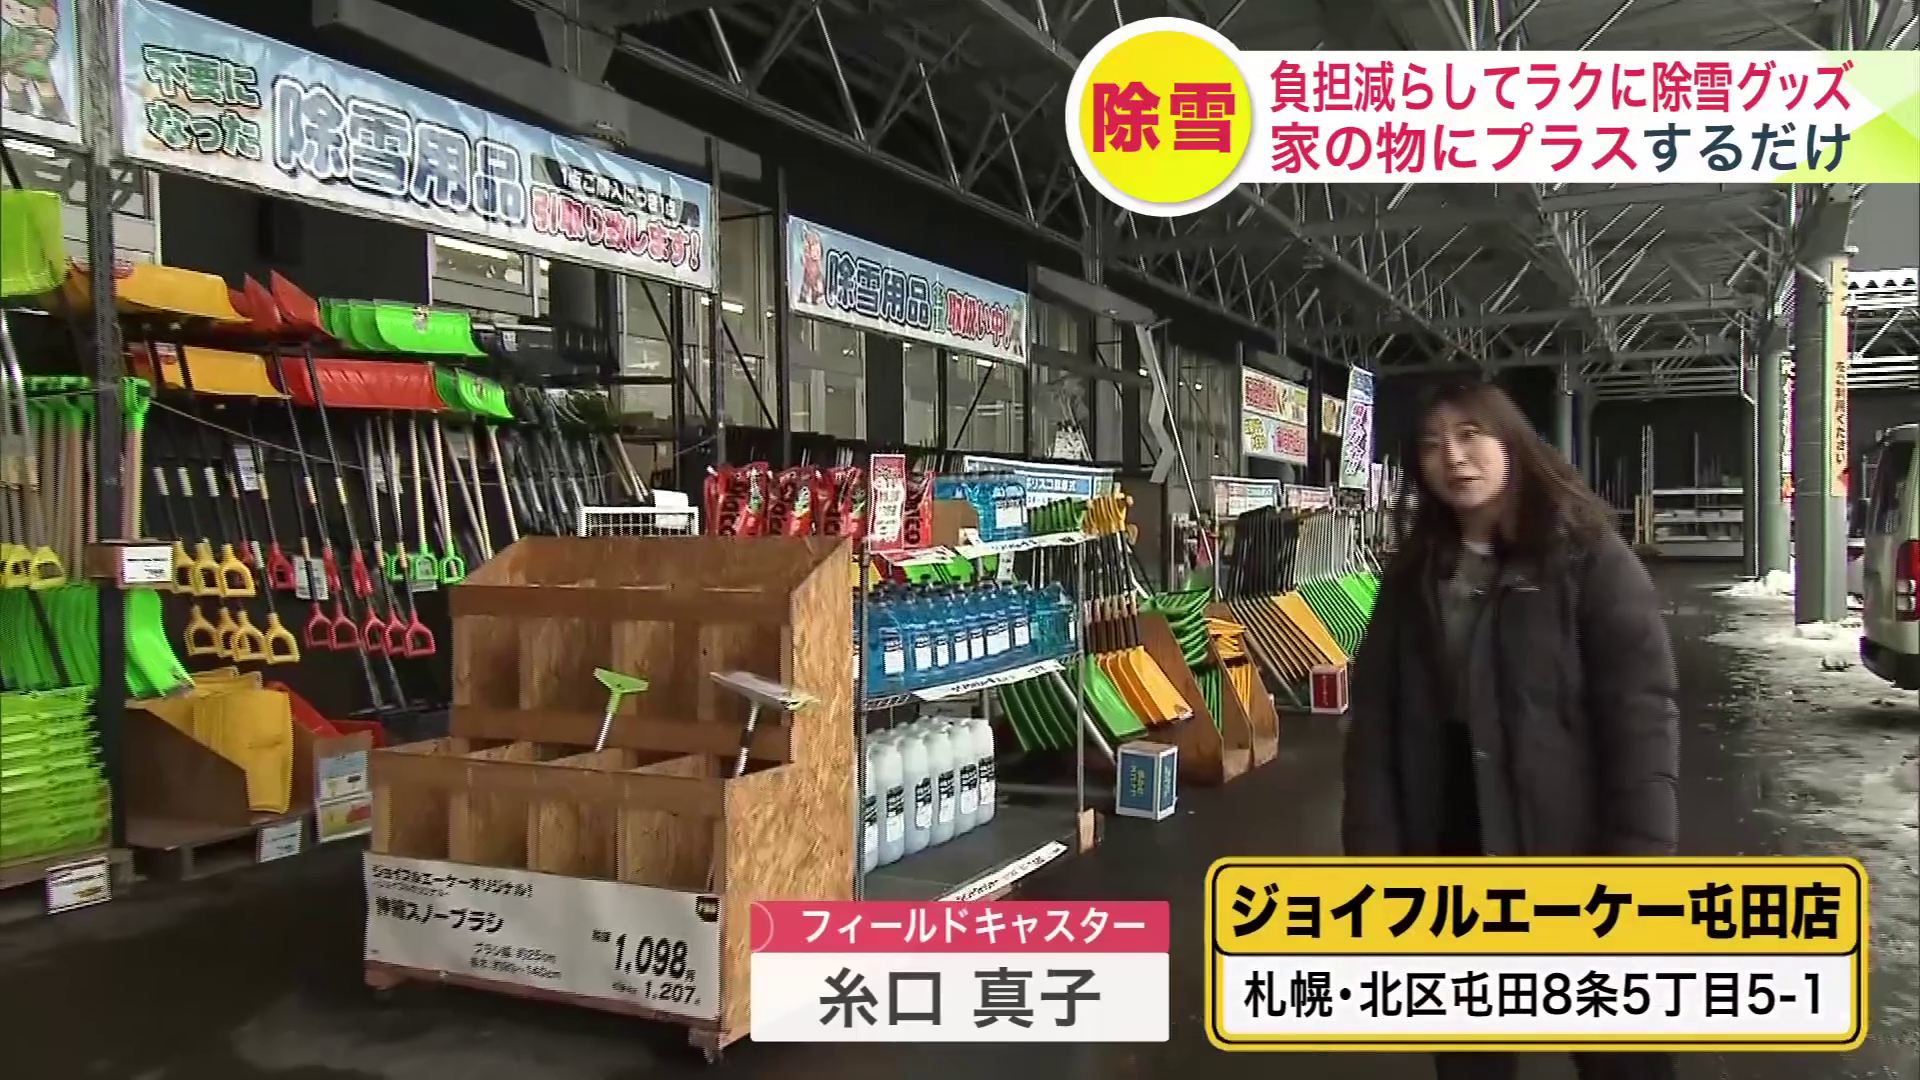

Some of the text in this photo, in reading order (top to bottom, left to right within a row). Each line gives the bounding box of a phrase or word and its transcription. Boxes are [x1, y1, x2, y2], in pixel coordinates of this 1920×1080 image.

[142, 45, 261, 108] 不要に
[146, 100, 262, 160] なった
[272, 75, 527, 226] 除雪用品
[826, 249, 931, 331] 除雪用品
